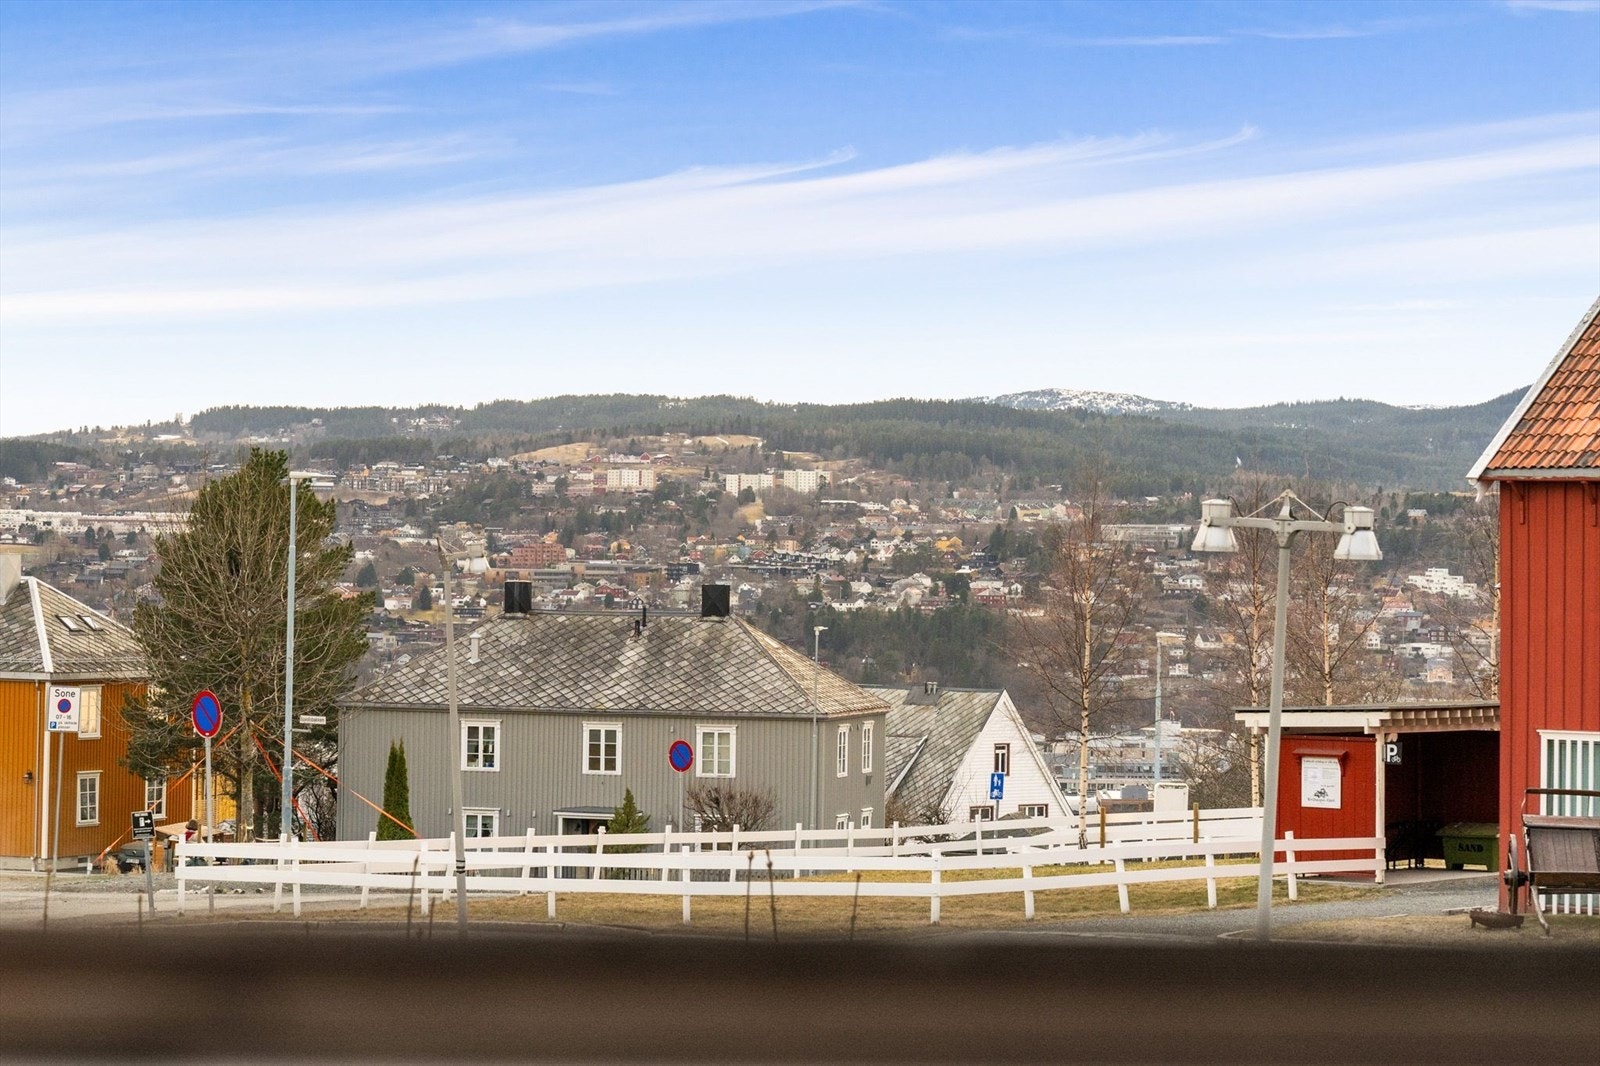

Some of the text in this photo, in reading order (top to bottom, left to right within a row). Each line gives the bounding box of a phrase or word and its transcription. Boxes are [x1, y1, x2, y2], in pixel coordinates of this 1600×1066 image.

[54, 688, 76, 698] Sone
[1386, 743, 1398, 763] P
[1457, 843, 1484, 852] SAND
